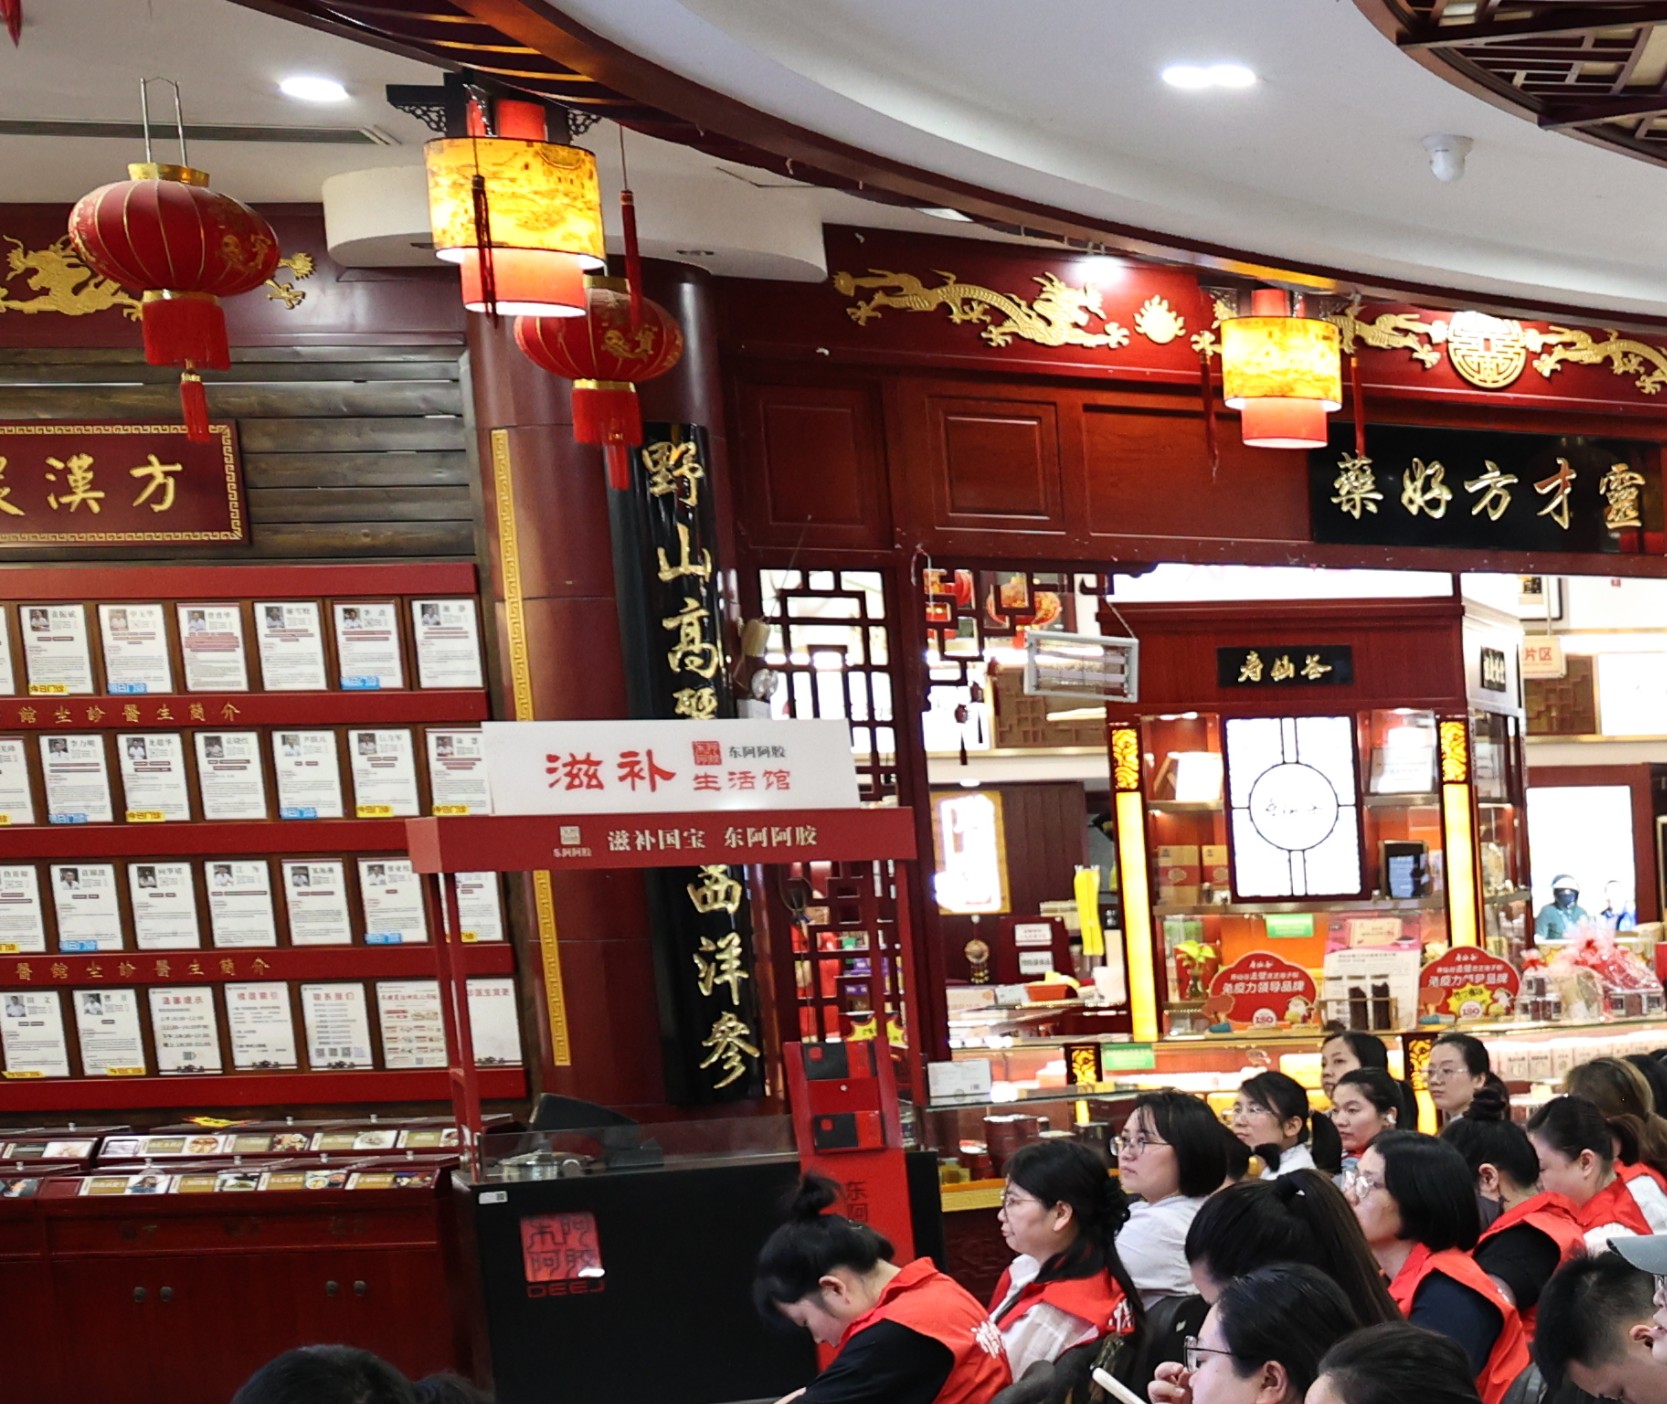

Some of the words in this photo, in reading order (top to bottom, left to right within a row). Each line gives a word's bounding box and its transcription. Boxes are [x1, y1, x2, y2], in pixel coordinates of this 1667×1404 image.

[728, 745, 787, 759] 东阿阿胶
[545, 749, 677, 792] 滋补
[693, 769, 792, 791] 生活馆
[608, 828, 706, 851] 滋补国宝
[723, 825, 818, 848] 东阿阿胶
[526, 1280, 606, 1298] DEEJ
